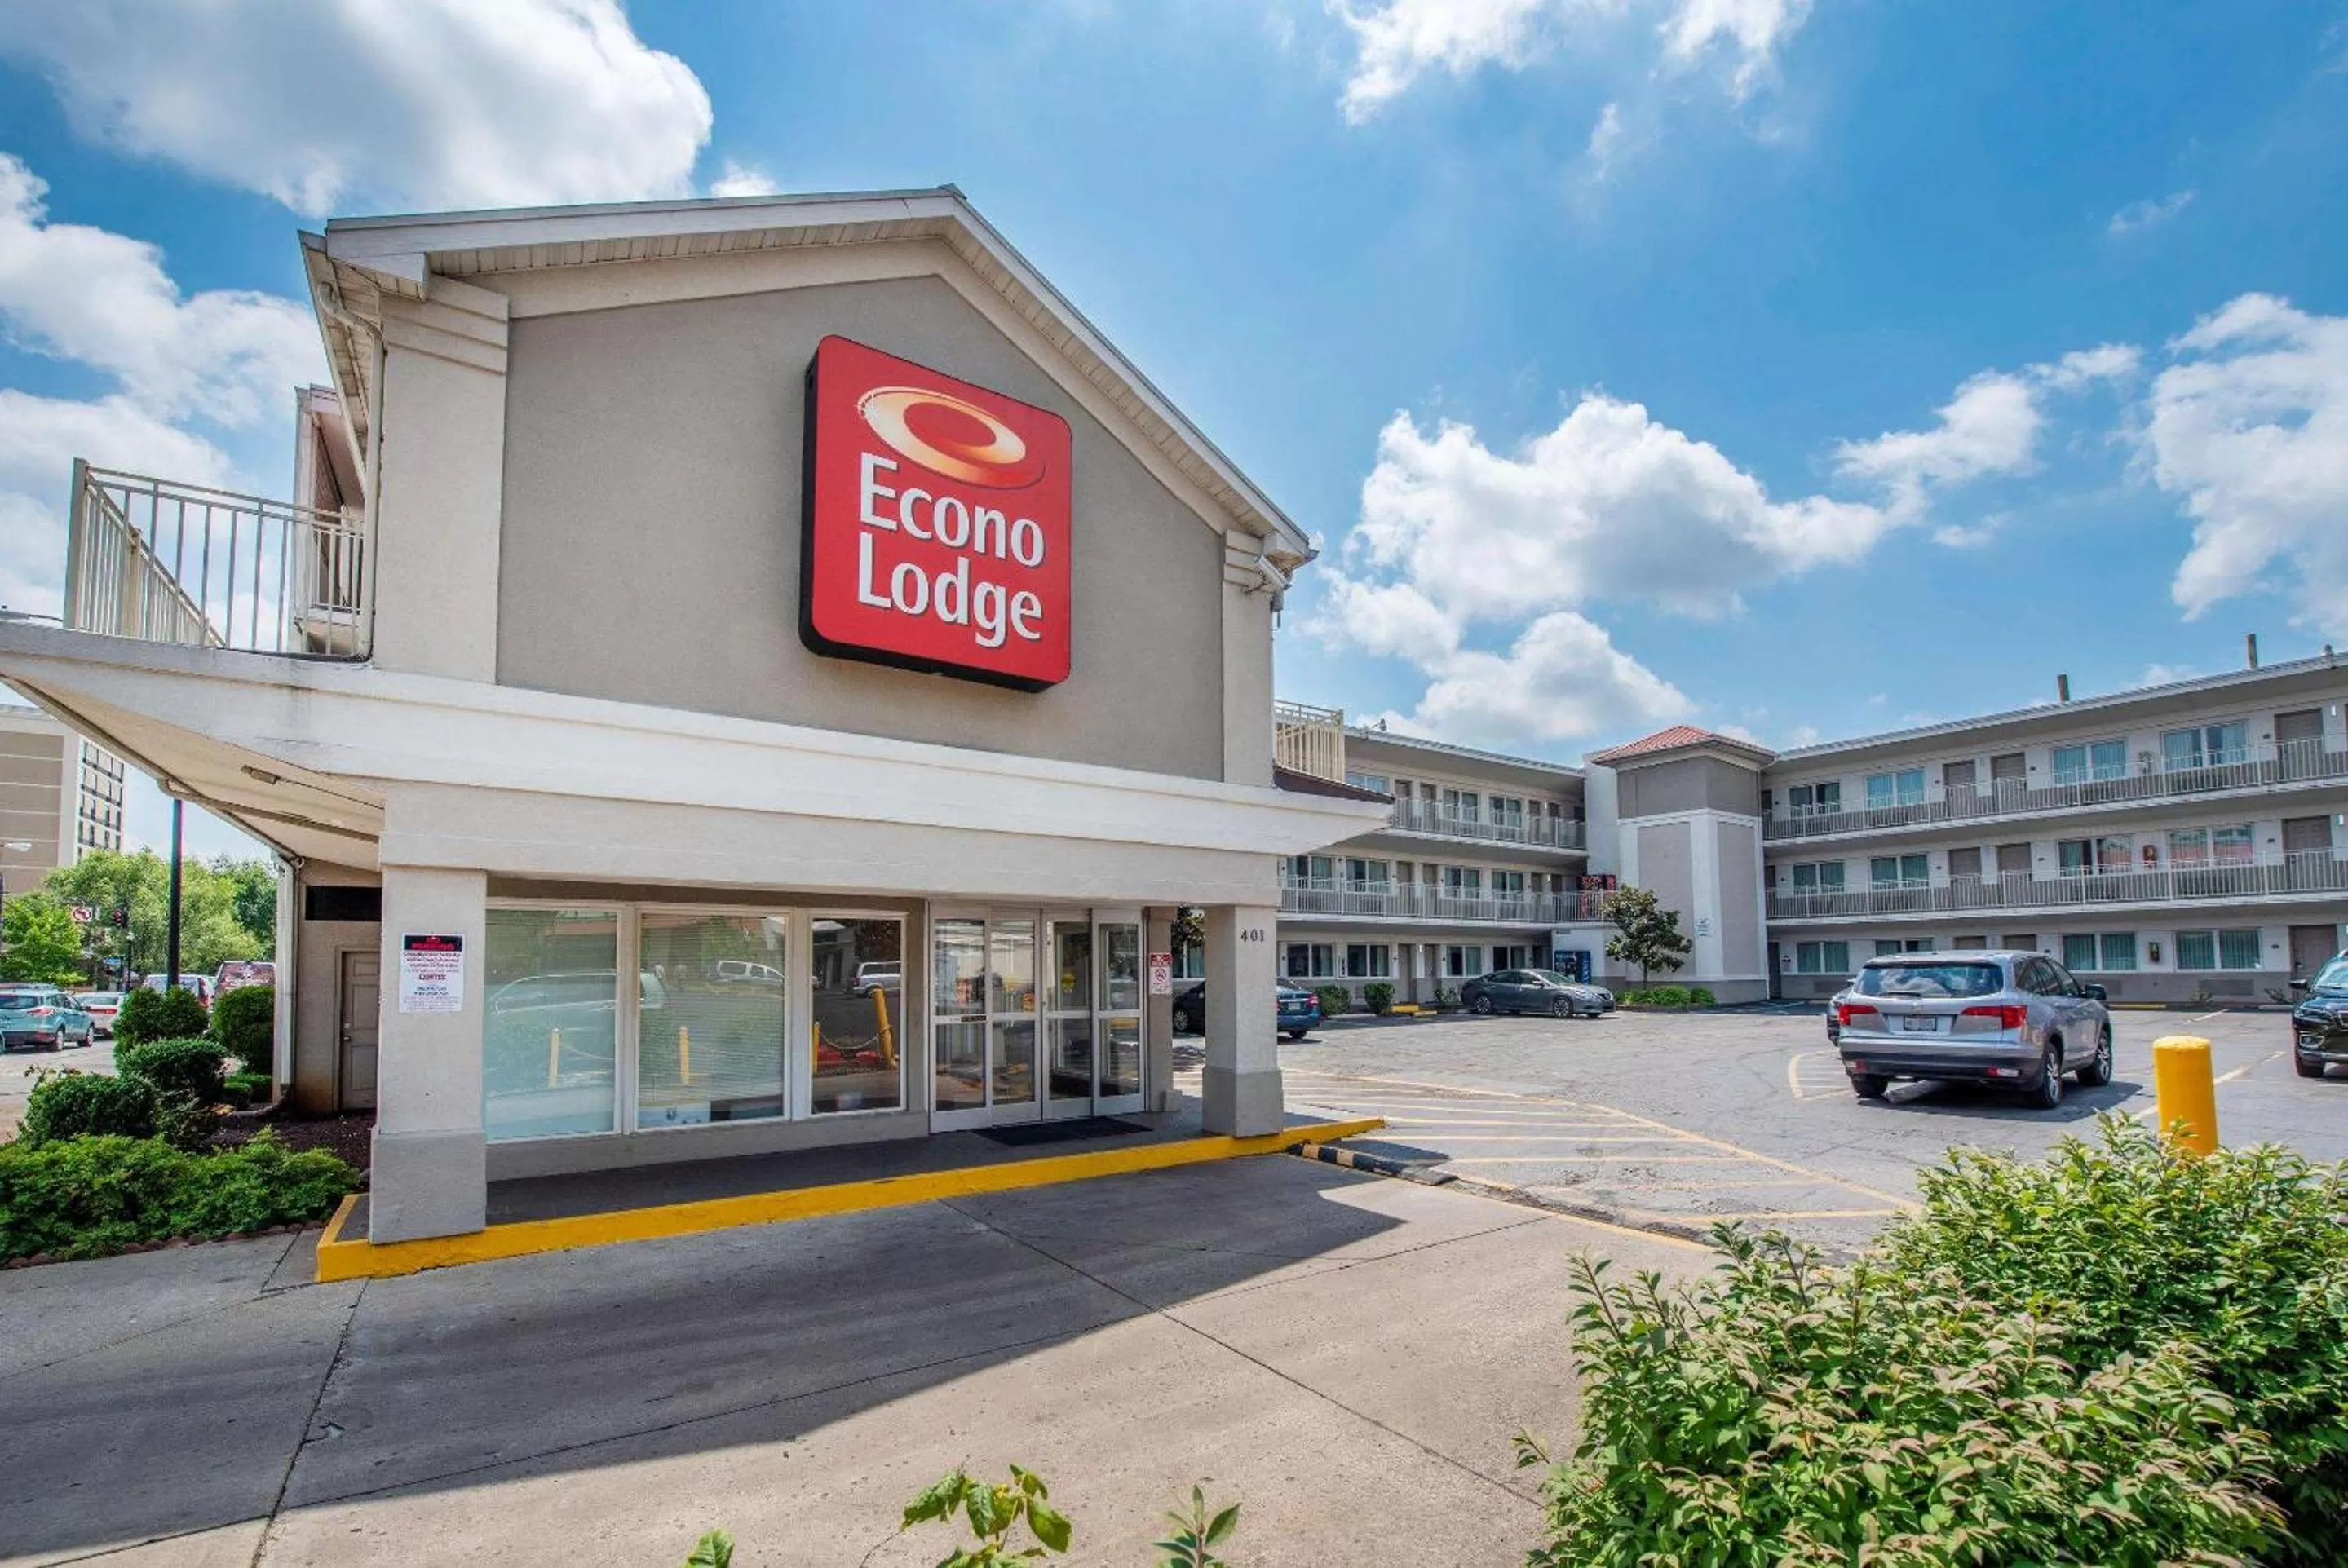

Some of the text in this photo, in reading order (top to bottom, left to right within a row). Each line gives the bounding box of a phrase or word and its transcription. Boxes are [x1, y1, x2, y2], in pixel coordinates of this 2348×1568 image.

[859, 452, 1046, 568] Econo
[857, 532, 1042, 647] Lodge
[1240, 928, 1264, 943] 401
